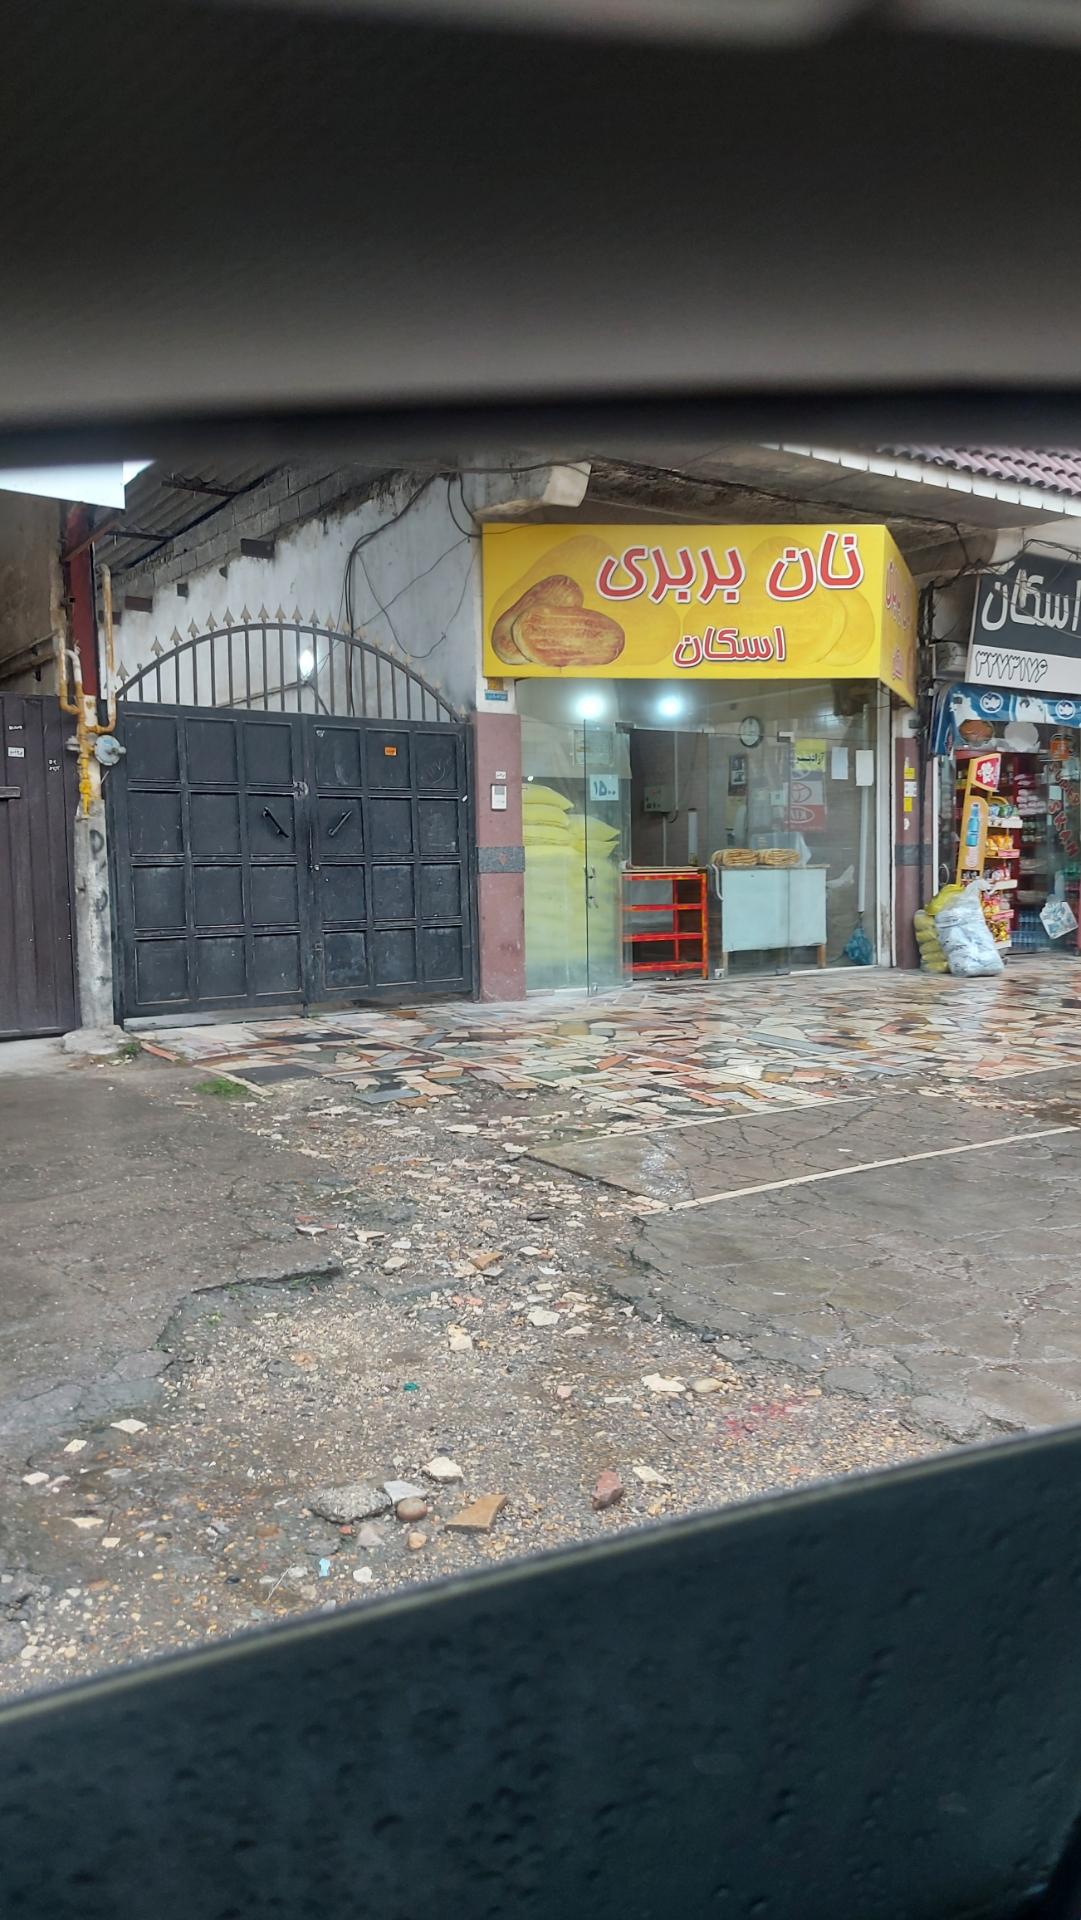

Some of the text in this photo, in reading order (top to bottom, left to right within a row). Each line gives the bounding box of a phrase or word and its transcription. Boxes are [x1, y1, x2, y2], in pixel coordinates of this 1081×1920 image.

[597, 546, 745, 603] بربری
[767, 530, 864, 601] نان
[981, 568, 1081, 632] اسکان
[673, 625, 786, 668] اسکان
[975, 650, 1048, 683] ۳۲۷۳۱۷۶
[593, 780, 616, 796] ۱۵۰۰
